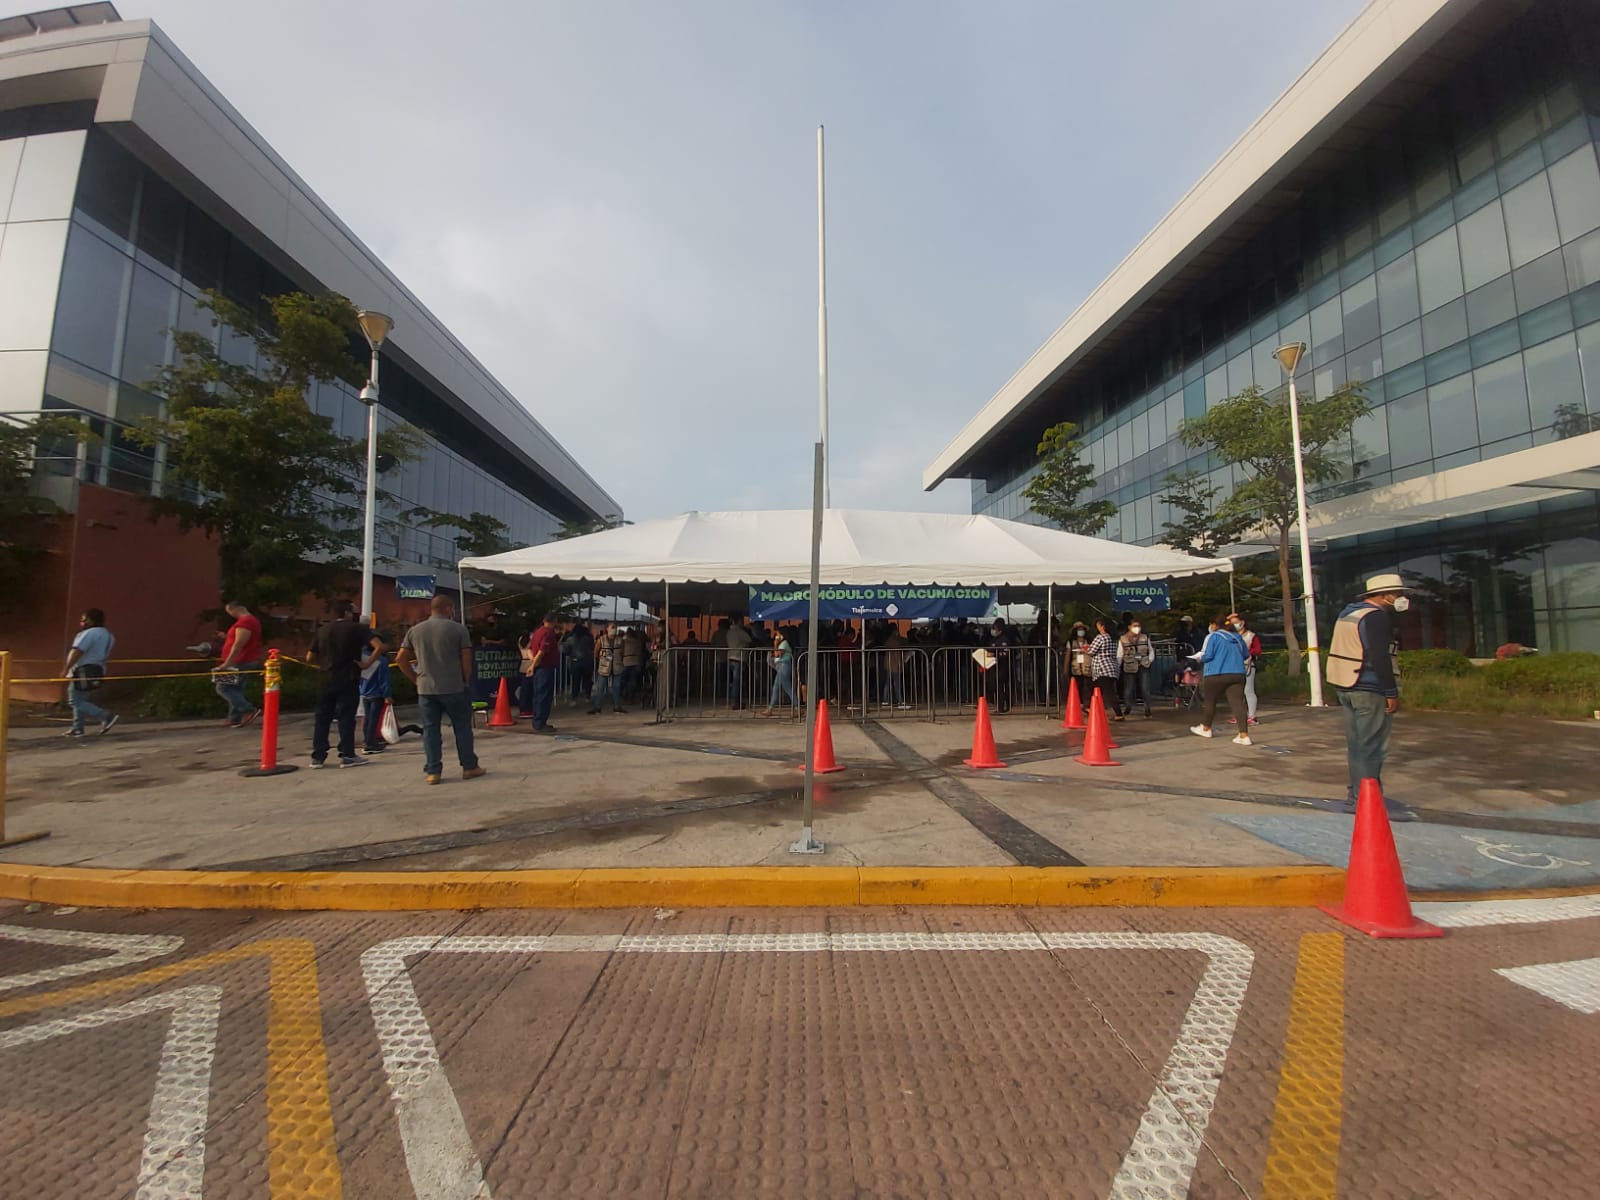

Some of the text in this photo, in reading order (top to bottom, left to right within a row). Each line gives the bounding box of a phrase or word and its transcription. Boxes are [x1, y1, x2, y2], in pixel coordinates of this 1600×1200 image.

[878, 589, 895, 599] DE
[1115, 587, 1164, 596] ENTRADA
[475, 650, 519, 661] ENTRADA
